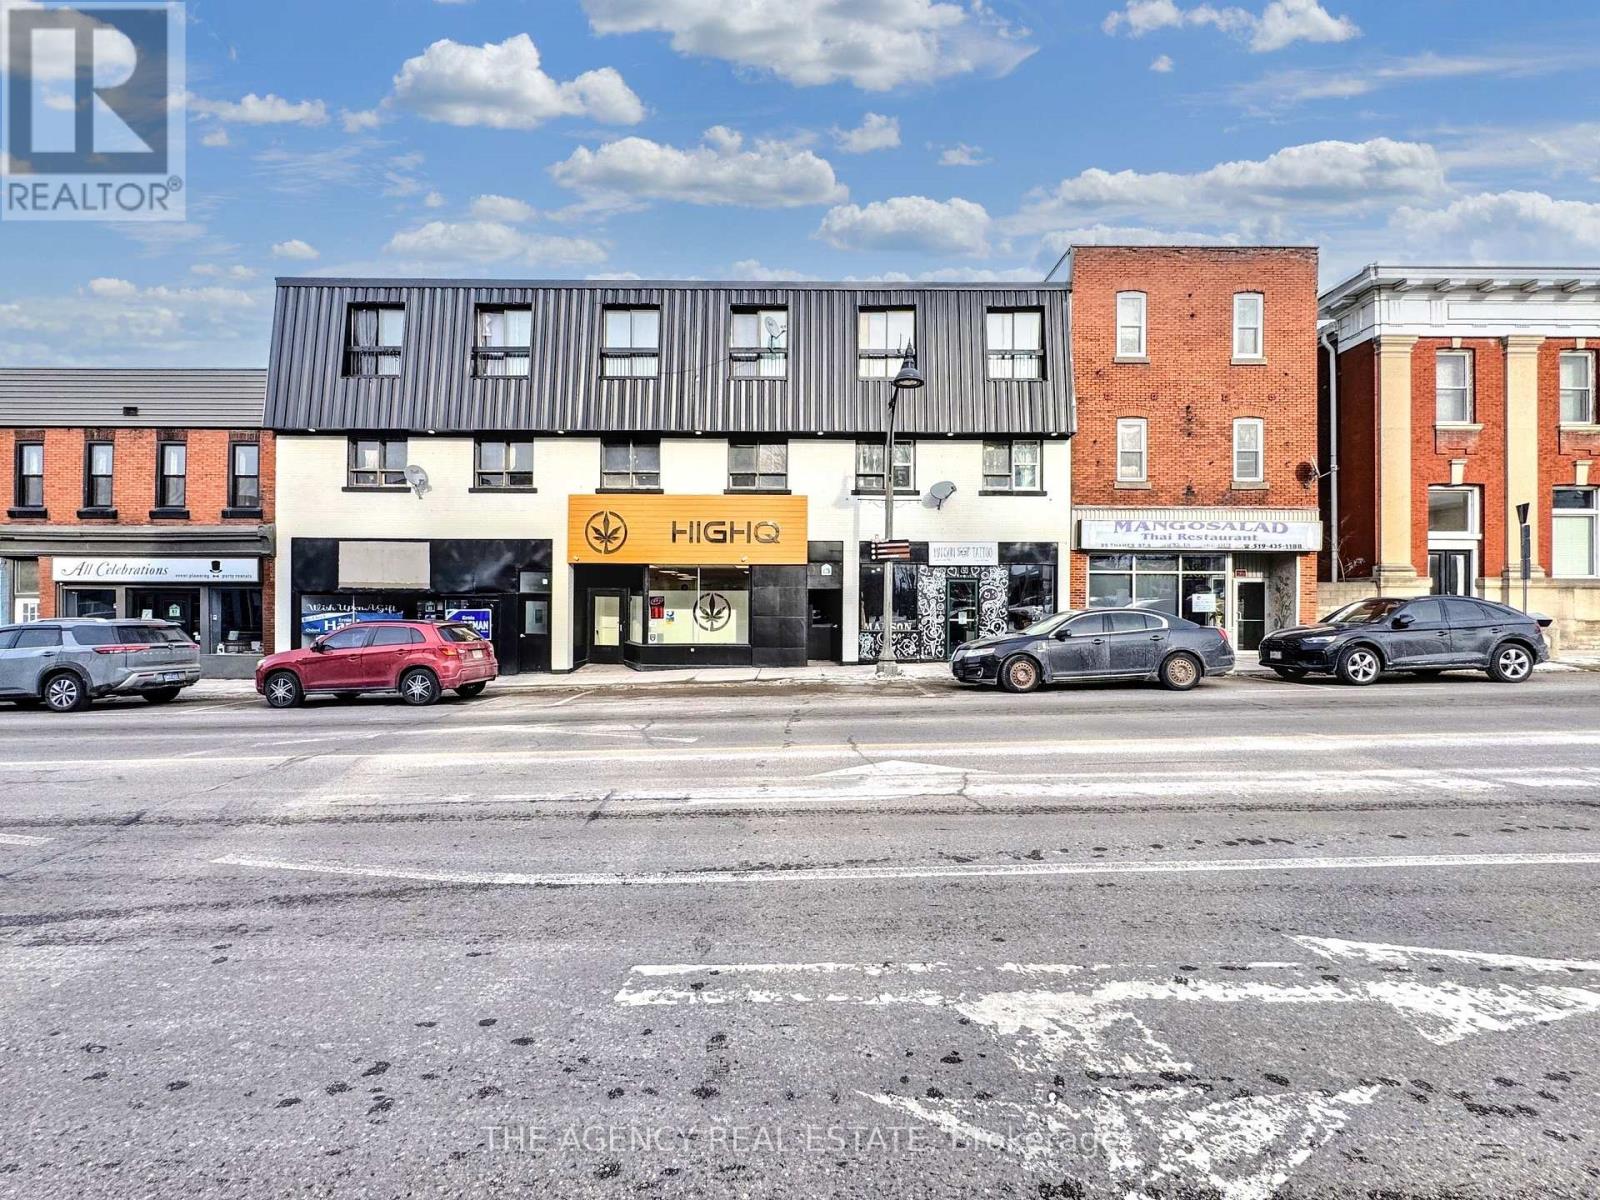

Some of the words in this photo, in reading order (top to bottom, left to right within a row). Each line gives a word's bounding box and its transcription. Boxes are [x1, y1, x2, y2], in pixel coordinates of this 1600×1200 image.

[671, 520, 781, 544] HIGHQ
[1141, 532, 1173, 541] Thai
[1177, 532, 1258, 541] Restaurant
[61, 561, 94, 576] All
[96, 561, 169, 577] Celebrations
[306, 603, 336, 612] Wish
